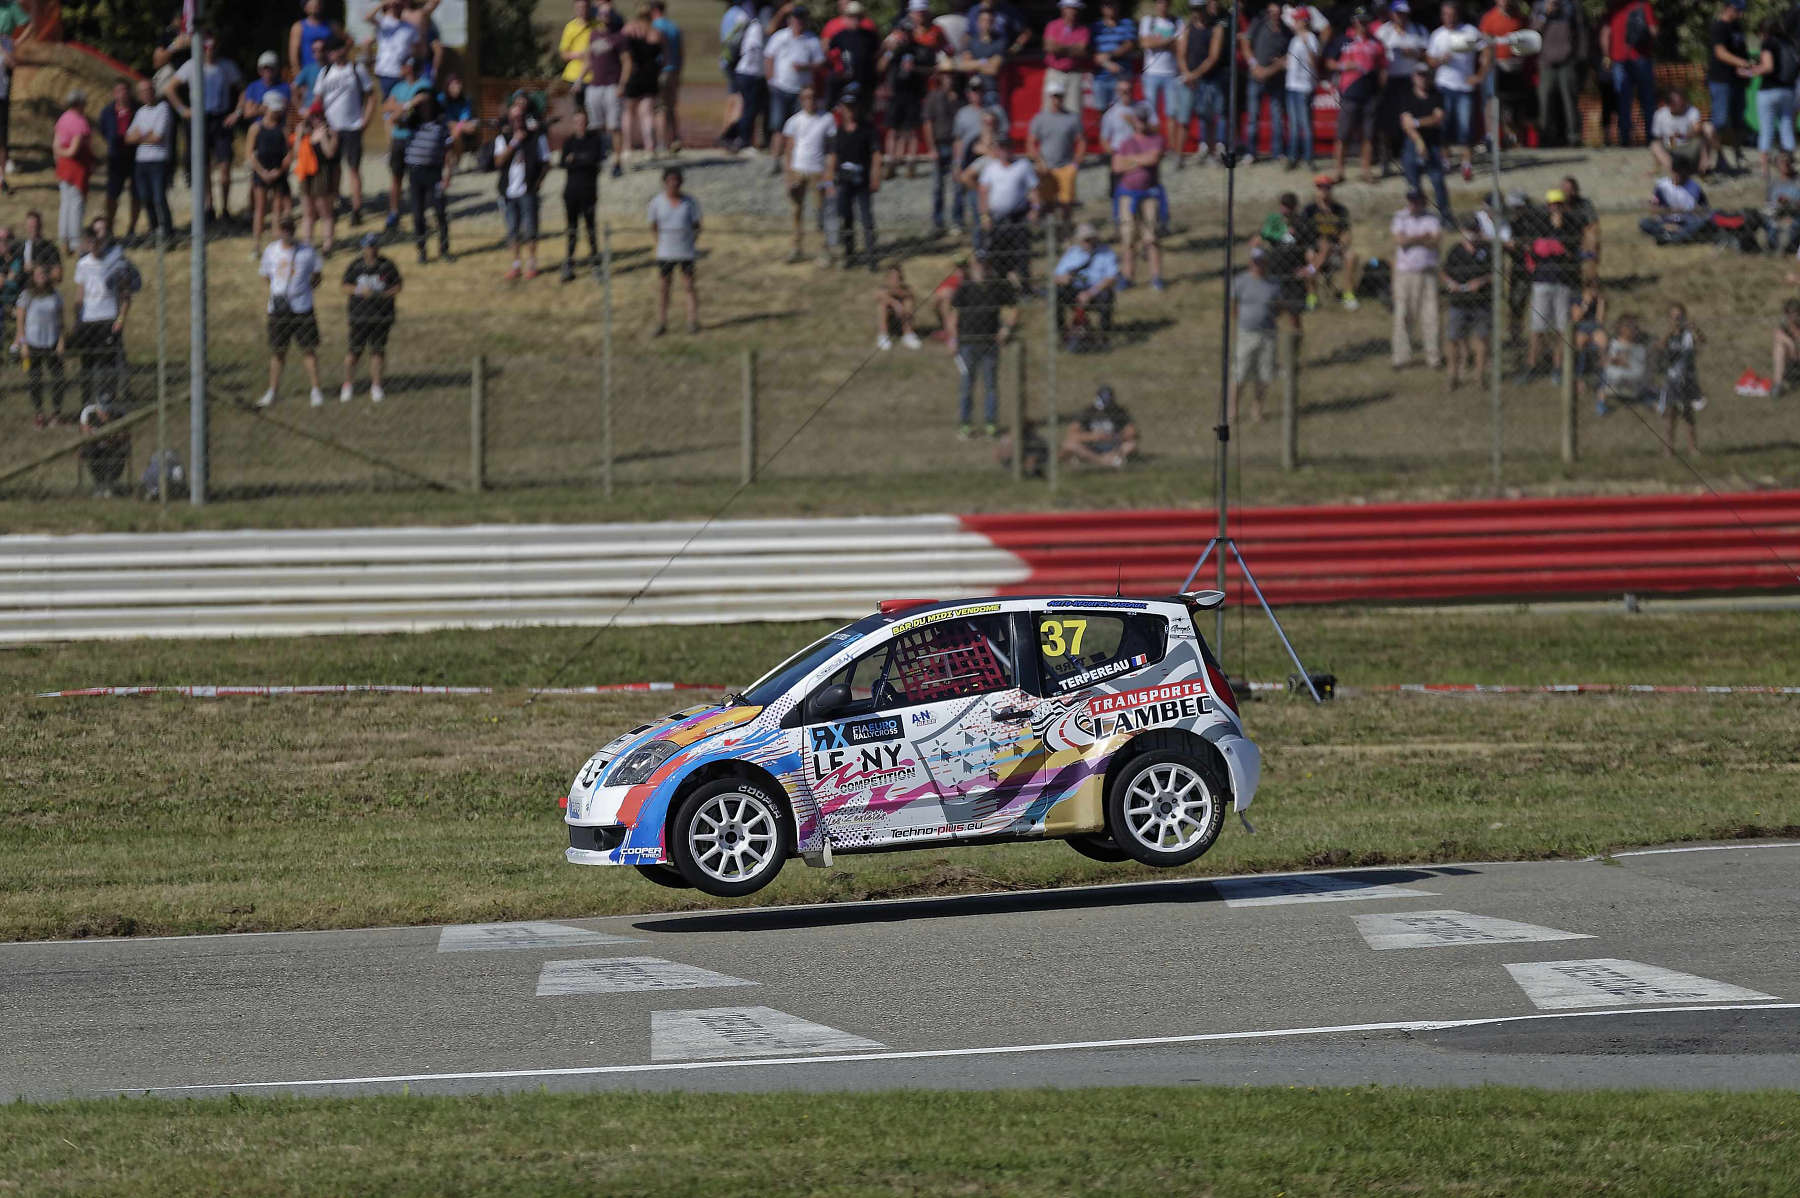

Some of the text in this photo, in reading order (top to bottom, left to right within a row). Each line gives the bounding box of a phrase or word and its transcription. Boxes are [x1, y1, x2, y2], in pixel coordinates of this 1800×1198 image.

[892, 603, 1002, 636] BAR DU MIDI VENDOME
[1040, 619, 1087, 657] 37
[1058, 659, 1130, 691] TERPEREAU
[1092, 682, 1202, 712] TRANSPORTS
[853, 727, 899, 741] RALLYCROSS
[1093, 695, 1213, 741] LAMBEC
[738, 784, 783, 820] COOPER
[891, 821, 985, 839] Techno-plus.eu
[620, 847, 663, 857] COOPER
